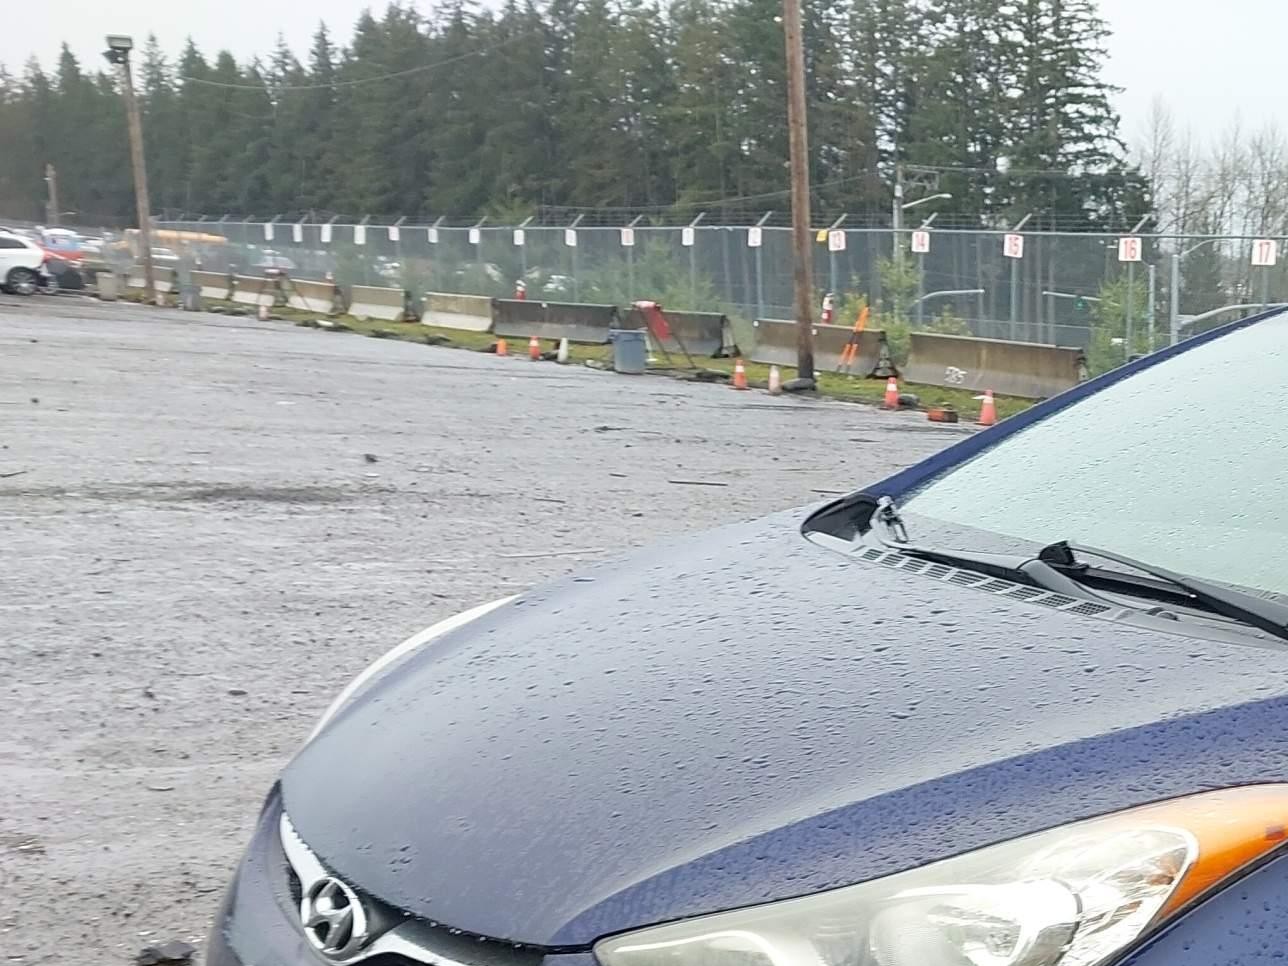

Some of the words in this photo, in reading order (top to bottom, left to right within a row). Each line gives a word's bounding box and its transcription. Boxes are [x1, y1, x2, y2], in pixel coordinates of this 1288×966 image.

[1008, 236, 1019, 255] 15
[1124, 239, 1137, 259] 16
[1258, 242, 1271, 263] 17
